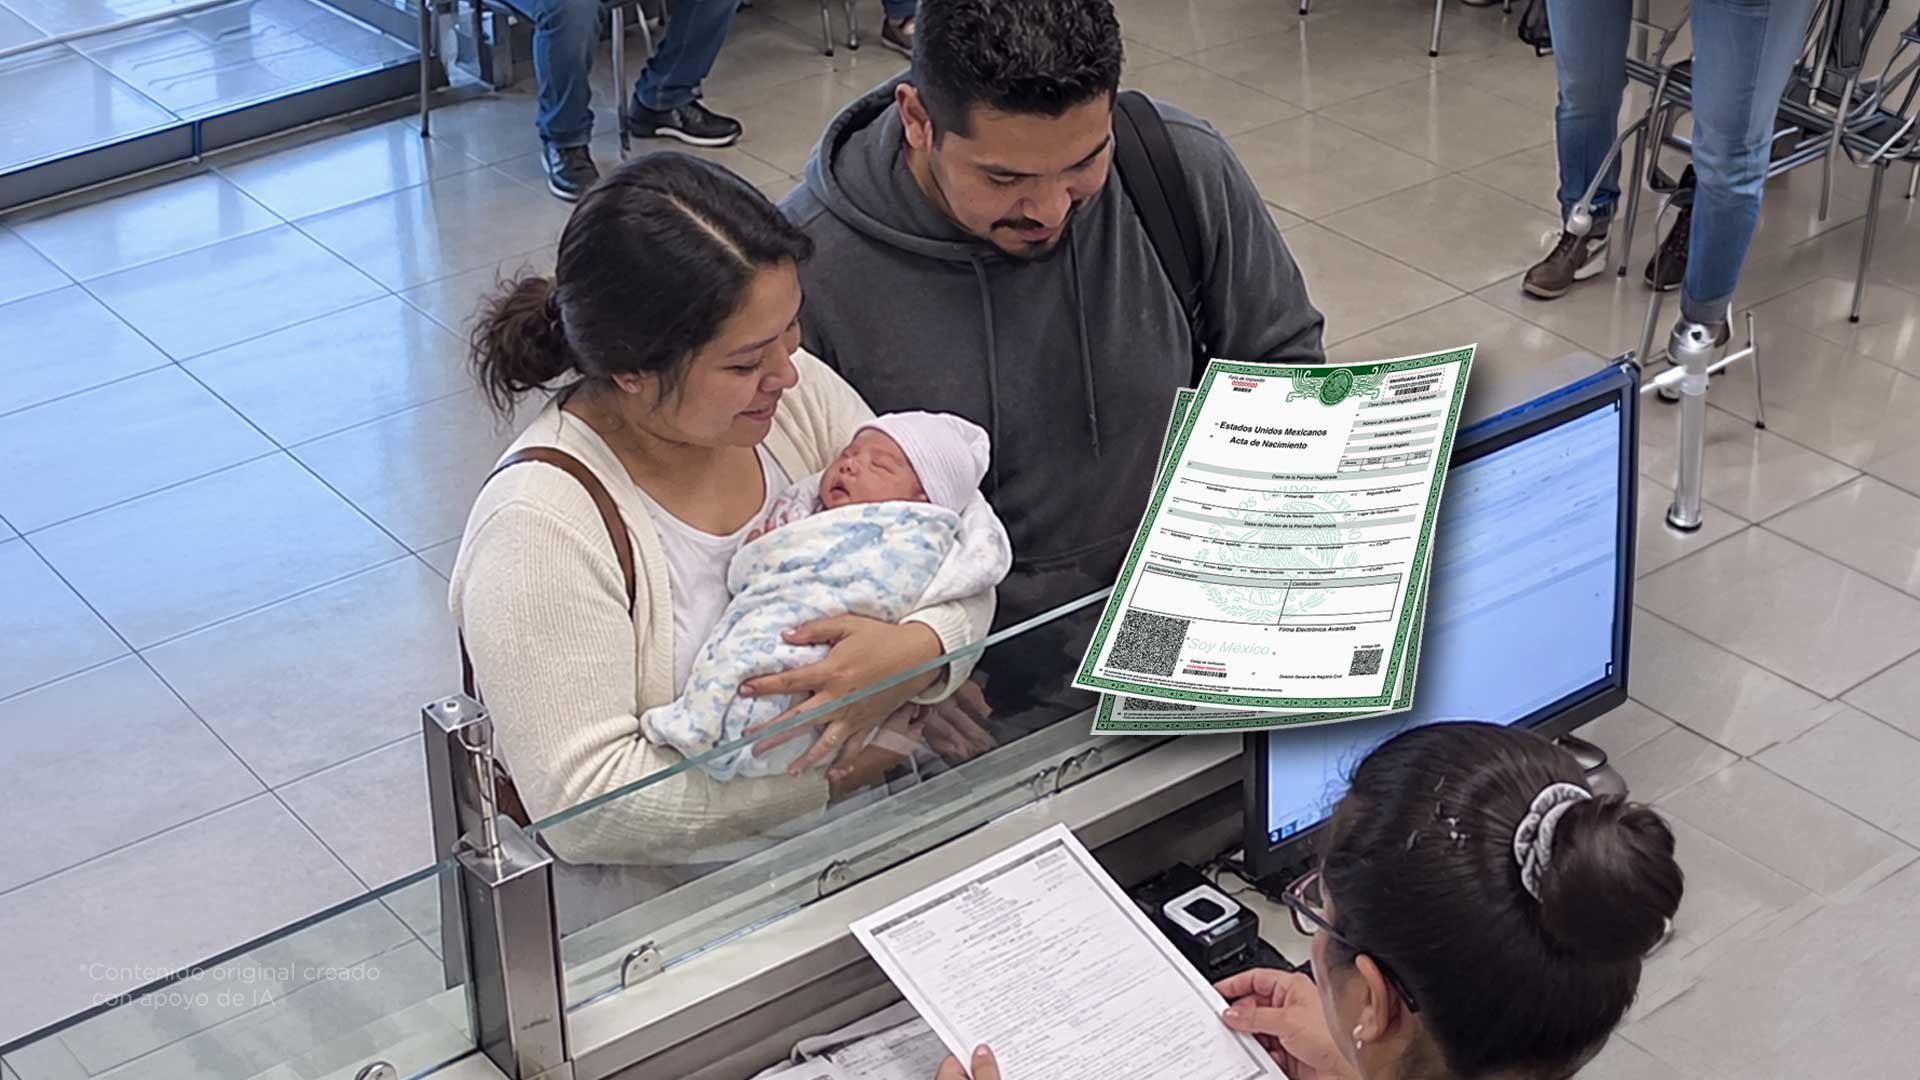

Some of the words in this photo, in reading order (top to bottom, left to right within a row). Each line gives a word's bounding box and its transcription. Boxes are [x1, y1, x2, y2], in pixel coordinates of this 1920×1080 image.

[1220, 421, 1252, 433] Estados
[1254, 426, 1282, 436] Unidos
[1284, 428, 1327, 436] Mexicanos
[1229, 436, 1248, 446] Acta
[1250, 439, 1260, 447] de
[1262, 440, 1308, 450] Nacimiento
[1187, 638, 1216, 654] Soy
[1220, 640, 1270, 656] México
